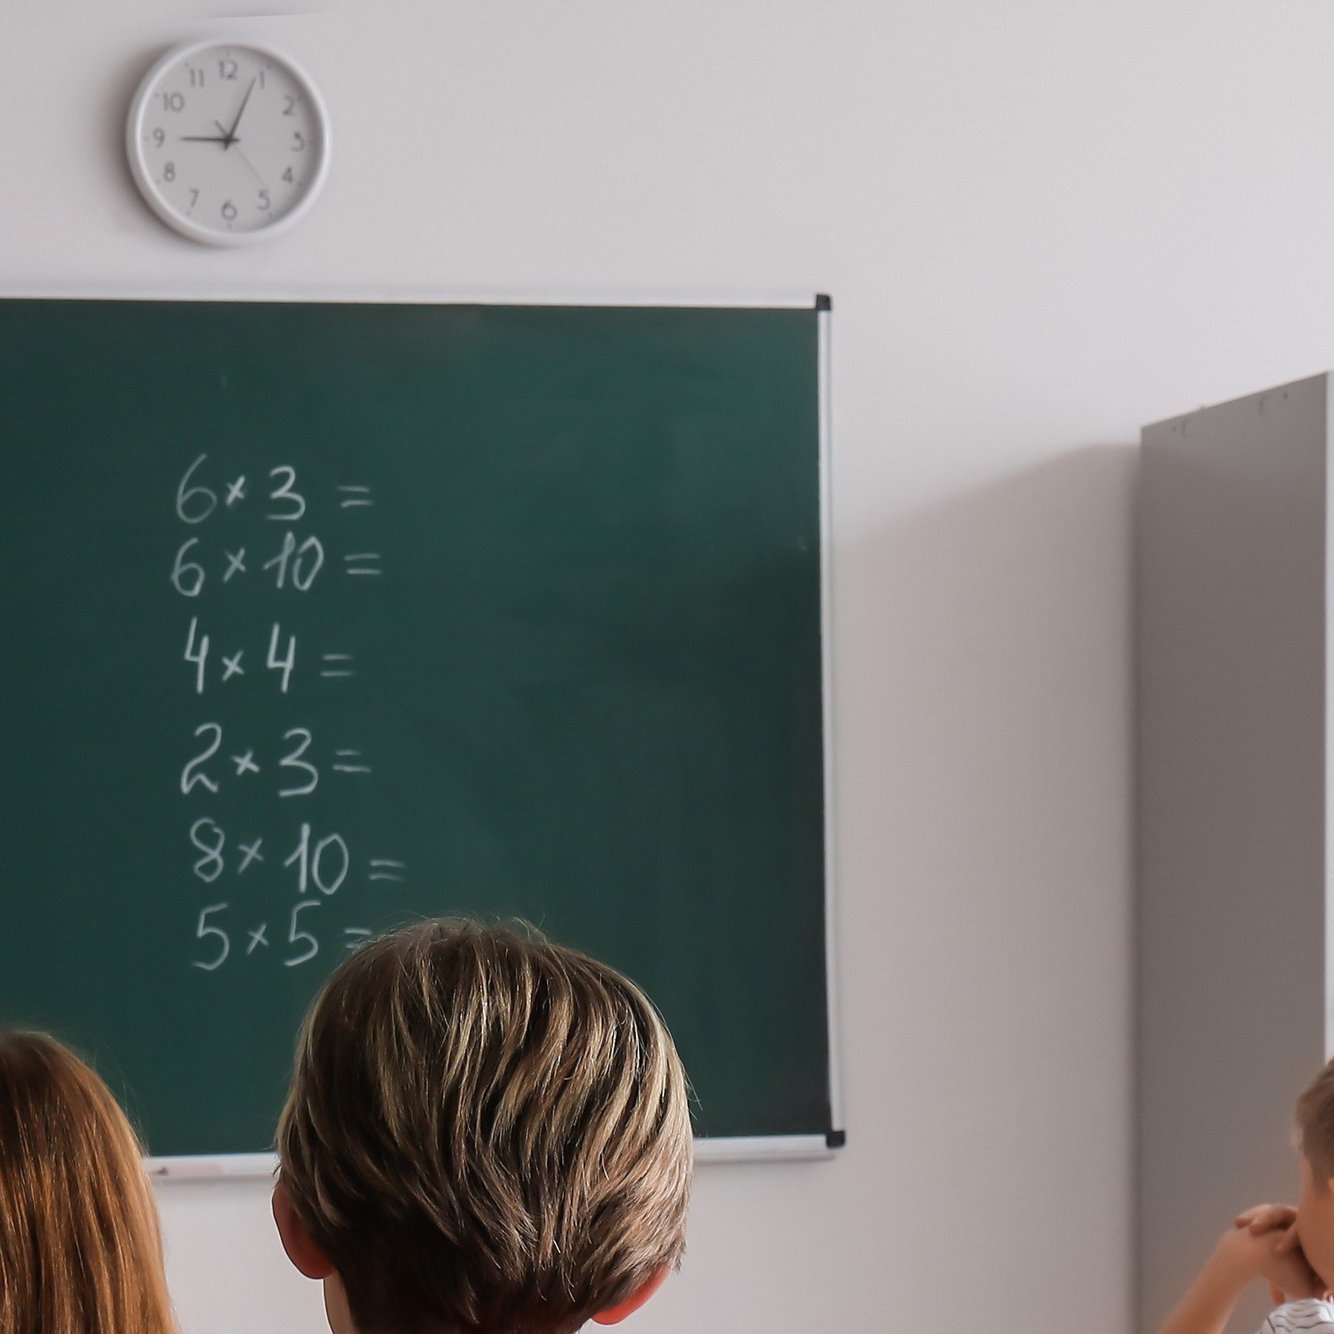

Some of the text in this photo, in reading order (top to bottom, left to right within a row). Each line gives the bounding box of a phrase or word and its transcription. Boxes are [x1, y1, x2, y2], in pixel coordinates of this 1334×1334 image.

[190, 69, 204, 87] 11
[219, 60, 238, 80] 12
[258, 70, 266, 89] 1
[163, 91, 185, 112] 10
[282, 96, 294, 115] 2
[153, 128, 165, 147] 9
[291, 132, 305, 151] 3
[163, 162, 175, 182] 8
[282, 166, 293, 183] 4
[189, 188, 199, 208] 7
[257, 190, 270, 210] 5
[221, 200, 238, 220] 6
[176, 453, 217, 524] 6
[266, 465, 306, 520] 3
[171, 538, 205, 596] 6
[263, 531, 324, 591] 10
[184, 616, 210, 694] 4
[267, 622, 296, 693] 4
[180, 722, 222, 794] 2
[278, 727, 319, 798] 3
[189, 816, 225, 883] 8
[283, 822, 349, 896] 10
[191, 902, 229, 971] 5
[284, 900, 321, 967] 5
